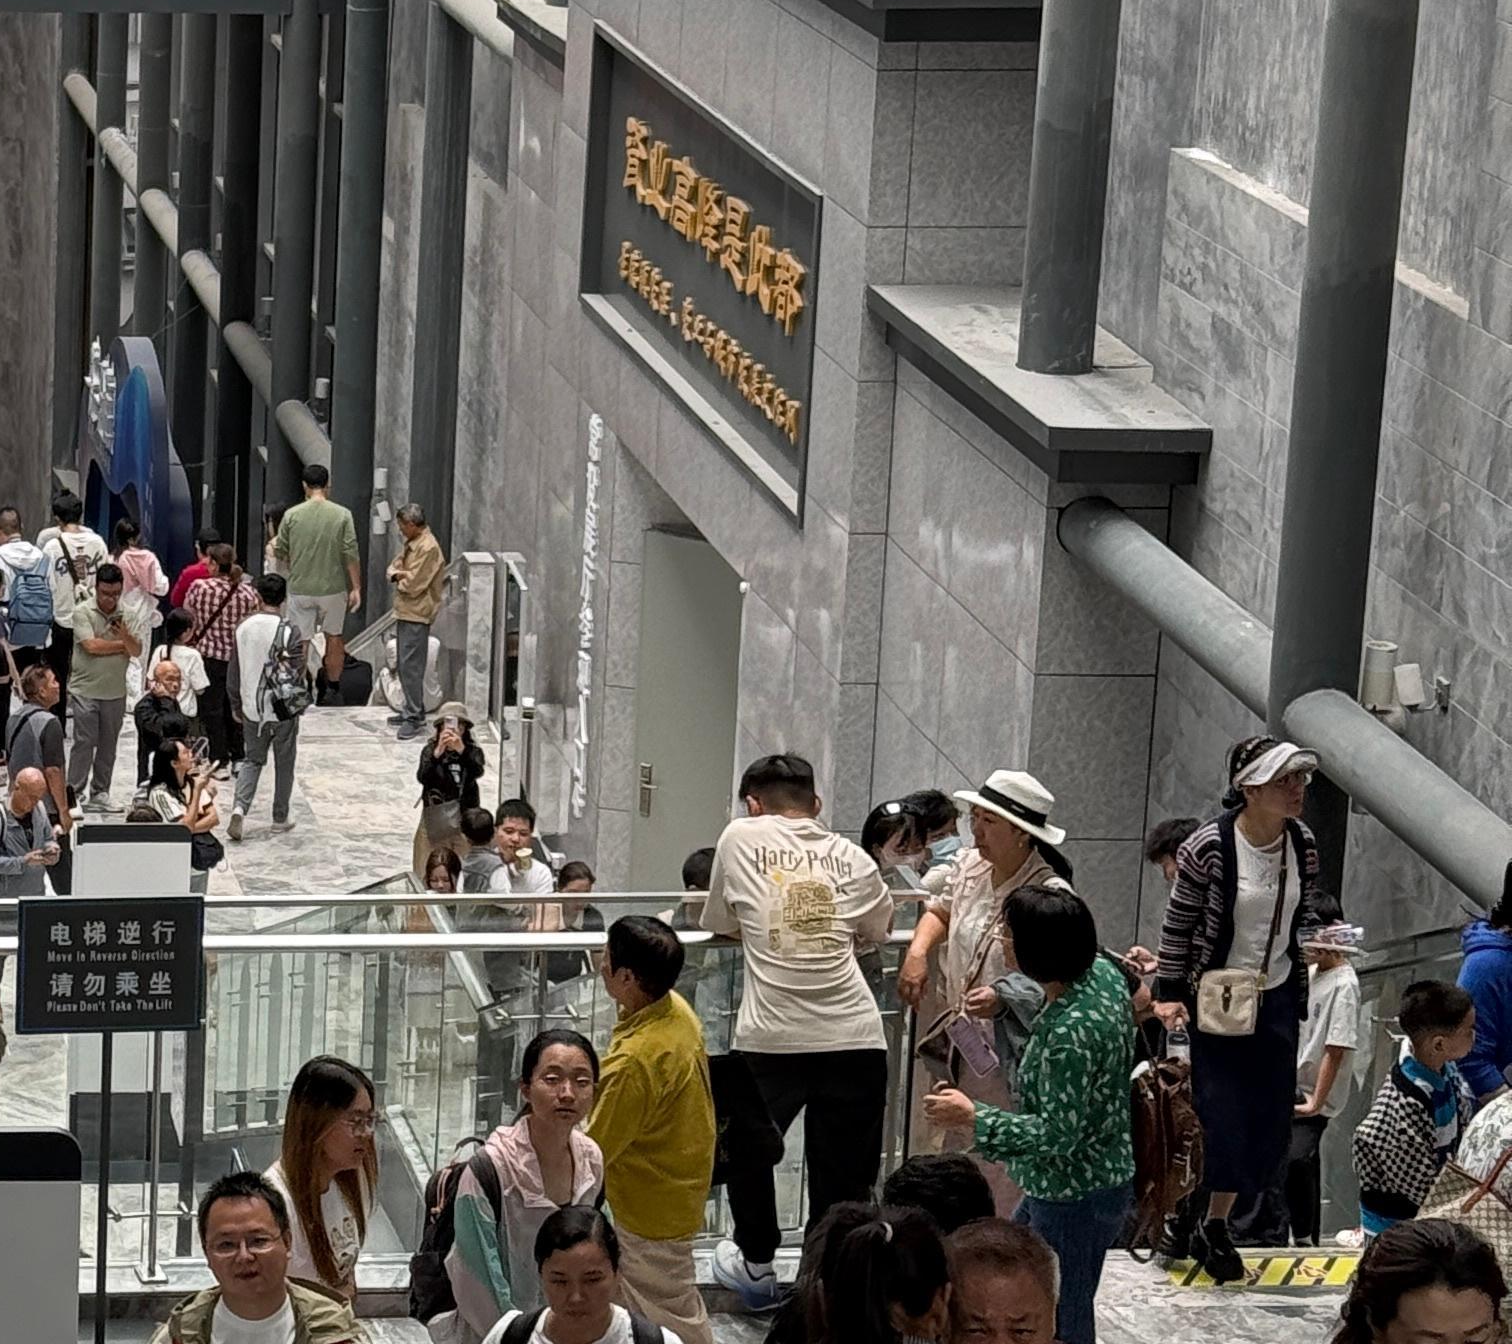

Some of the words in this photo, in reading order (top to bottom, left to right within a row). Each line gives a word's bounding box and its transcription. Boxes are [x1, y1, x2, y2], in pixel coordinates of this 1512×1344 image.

[753, 846, 803, 875] Harry
[805, 850, 852, 879] Potter
[50, 920, 176, 946] 电梯逆行
[47, 950, 73, 963] Move
[90, 950, 127, 962] Reverse
[131, 948, 175, 961] Direction
[49, 971, 172, 997] 请勿乘坐
[79, 1000, 106, 1012] Don't
[110, 999, 132, 1012] Take
[136, 998, 154, 1011] The
